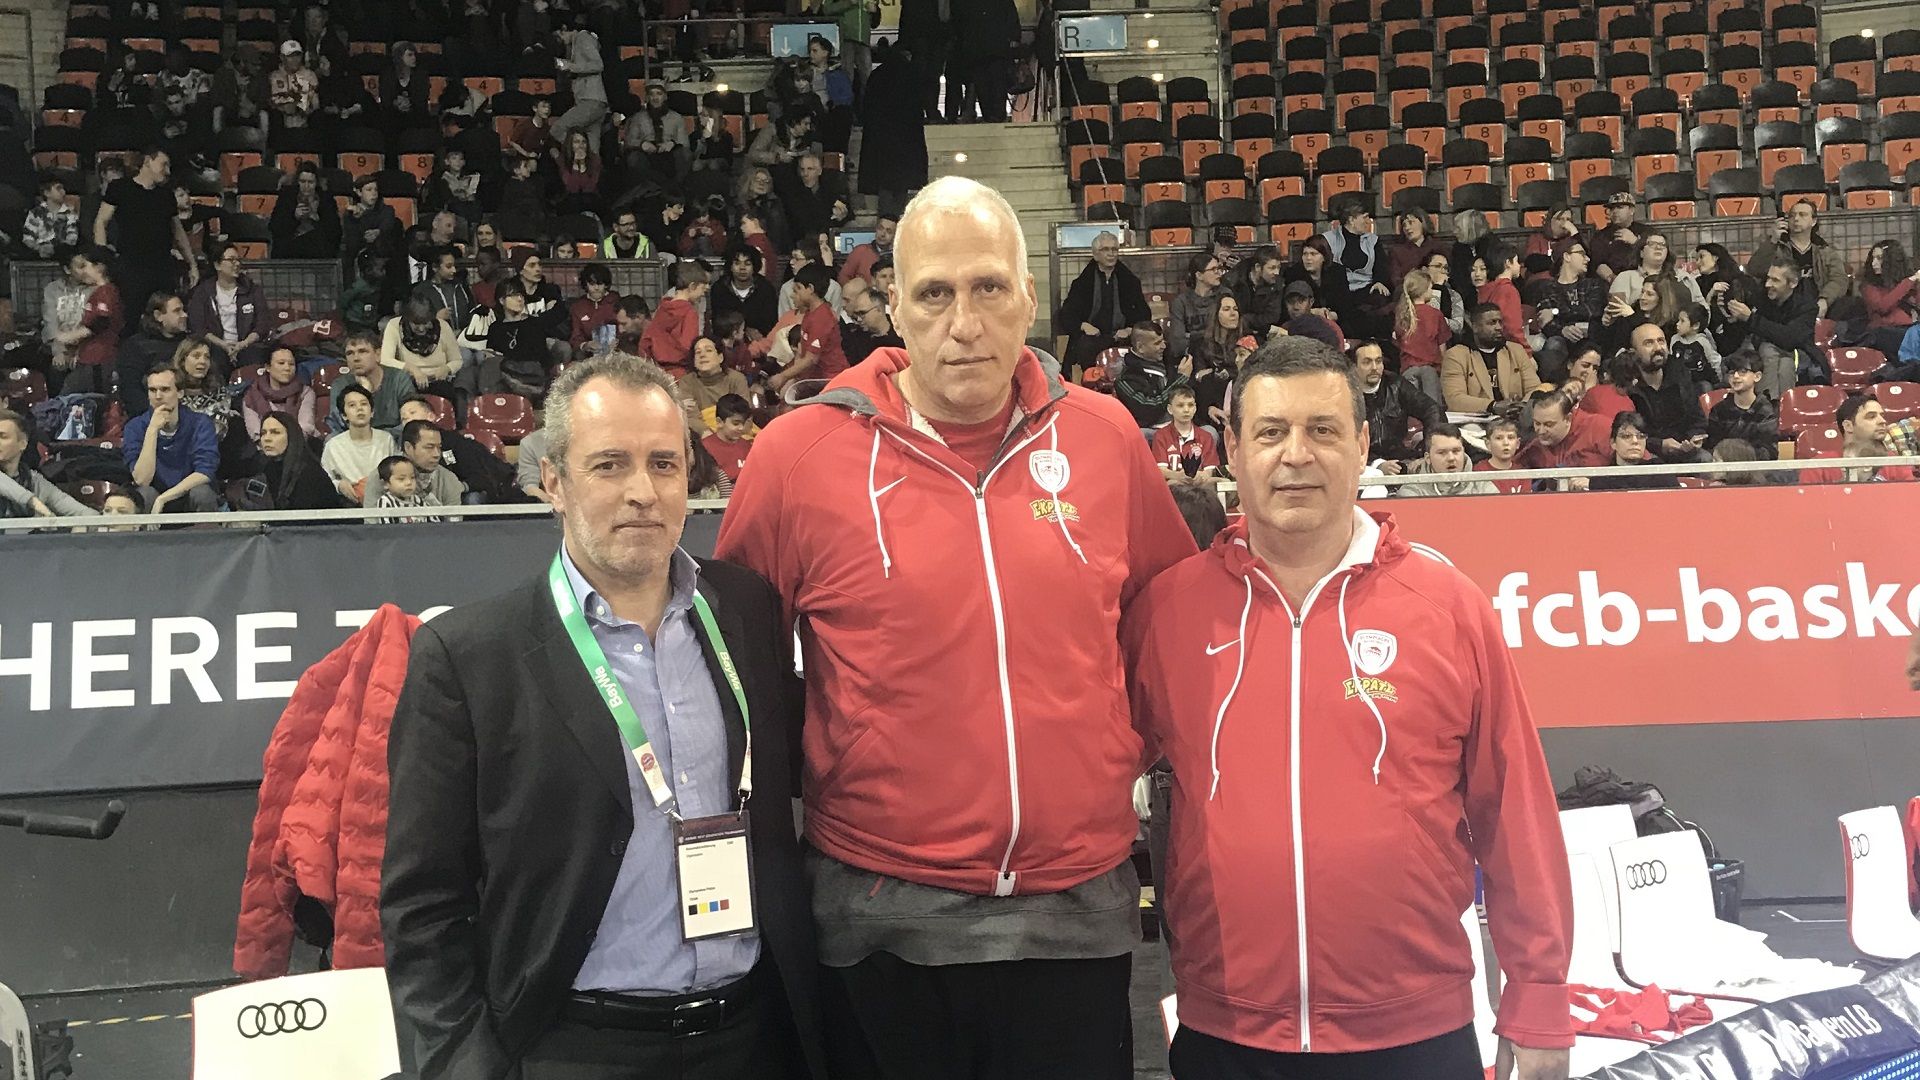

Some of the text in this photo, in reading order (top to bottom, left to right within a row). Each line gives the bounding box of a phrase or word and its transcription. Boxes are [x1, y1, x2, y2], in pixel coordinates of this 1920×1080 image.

[1064, 26, 1092, 48] R 2
[1793, 70, 1802, 81] 5
[1850, 66, 1860, 76] 4
[1683, 76, 1691, 87] 7
[1738, 72, 1748, 84] 6
[479, 80, 488, 90] 4
[1517, 85, 1526, 96] 9
[1569, 81, 1582, 93] 10
[1626, 79, 1635, 90] 8
[1463, 88, 1472, 100] 8
[1250, 100, 1259, 111] 4
[1351, 96, 1360, 106] 6
[1896, 99, 1907, 111] 4
[1089, 108, 1094, 118] 1
[1136, 106, 1145, 117] 2
[1776, 111, 1784, 122] 6
[1834, 107, 1843, 118] 5
[1655, 116, 1664, 128] 8
[1715, 113, 1724, 124] 7
[1538, 122, 1548, 134] 9
[1597, 119, 1606, 131] 9
[1365, 133, 1374, 144] 6
[1422, 130, 1430, 142] 7
[1481, 127, 1490, 138] 8
[1198, 142, 1207, 154] 3
[1249, 141, 1258, 151] 4
[1307, 136, 1315, 148] 5
[1902, 142, 1912, 153] 4
[1140, 146, 1148, 157] 2
[1777, 151, 1787, 163] 6
[1842, 148, 1851, 161] 5
[357, 155, 367, 167] 9
[418, 157, 427, 169] 8
[1652, 158, 1662, 170] 8
[1714, 154, 1723, 166] 7
[1463, 169, 1472, 181] 7
[1526, 167, 1535, 179] 8
[1587, 163, 1596, 175] 9
[1337, 176, 1346, 188] 5
[1398, 173, 1408, 185] 6
[1160, 185, 1169, 197] 2
[1221, 182, 1230, 195] 3
[1277, 180, 1286, 192] 4
[1101, 187, 1107, 199] 1
[256, 197, 265, 209] 7
[1866, 193, 1875, 206] 5
[1668, 204, 1678, 217] 8
[1733, 201, 1743, 213] 7
[1167, 231, 1176, 244] 2
[1287, 226, 1296, 238] 4
[0, 611, 299, 711] HERE
[719, 651, 740, 691] BayWa
[595, 665, 623, 708] BayWa
